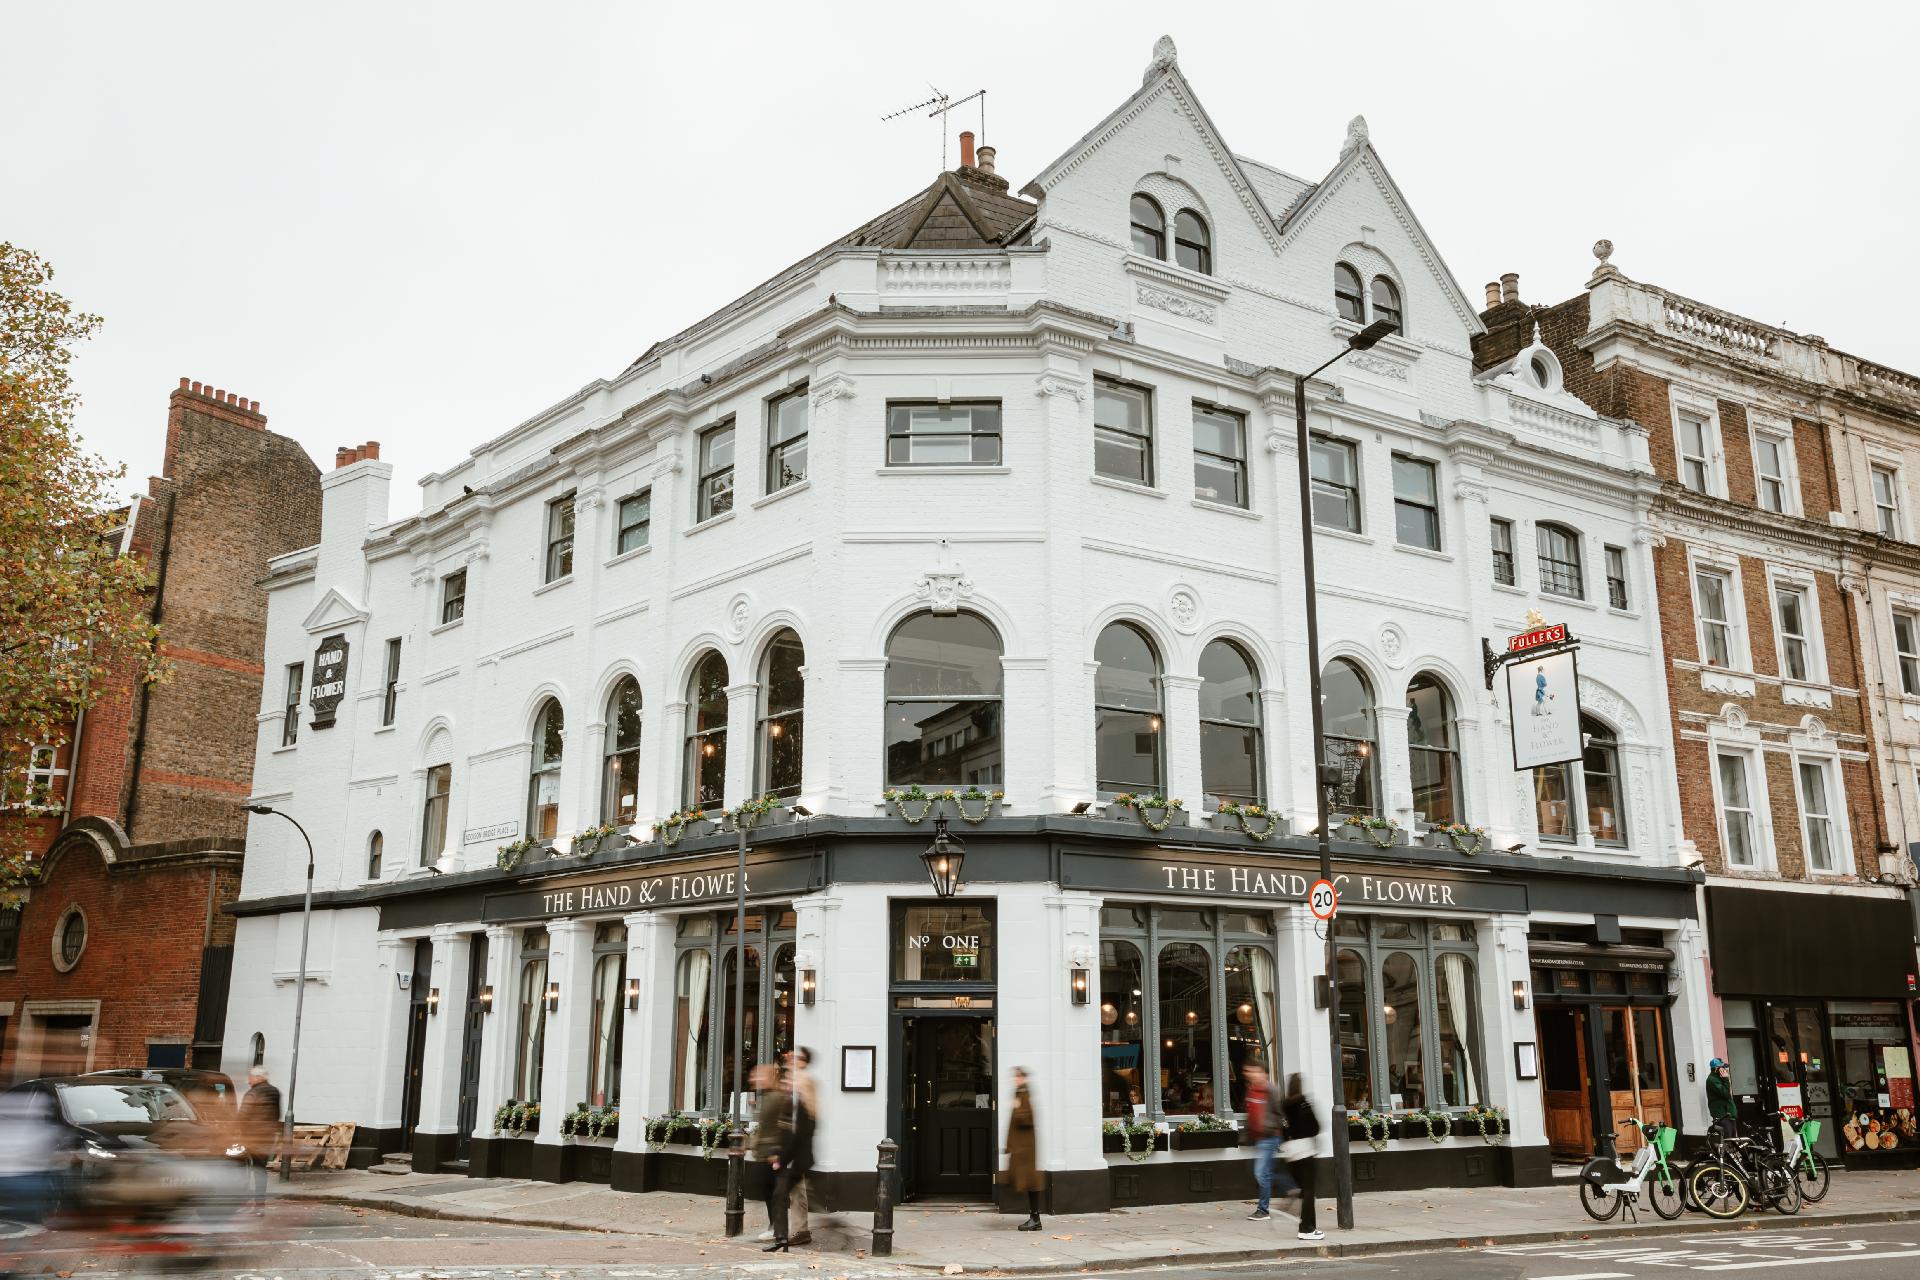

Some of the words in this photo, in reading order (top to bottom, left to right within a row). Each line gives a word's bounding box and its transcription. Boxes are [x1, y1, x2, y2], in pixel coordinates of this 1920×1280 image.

[1511, 628, 1561, 649] FULLER'S
[318, 649, 343, 667] HAND
[325, 668, 333, 679] &
[312, 680, 344, 701] FLOWER
[1162, 866, 1216, 891] THE
[1230, 867, 1307, 897] HAND
[1361, 875, 1456, 906] FLOWER
[543, 892, 573, 913] THE
[580, 885, 632, 910] HAND
[639, 879, 663, 904] &
[1313, 890, 1333, 908] 20
[942, 935, 979, 949] ONE
